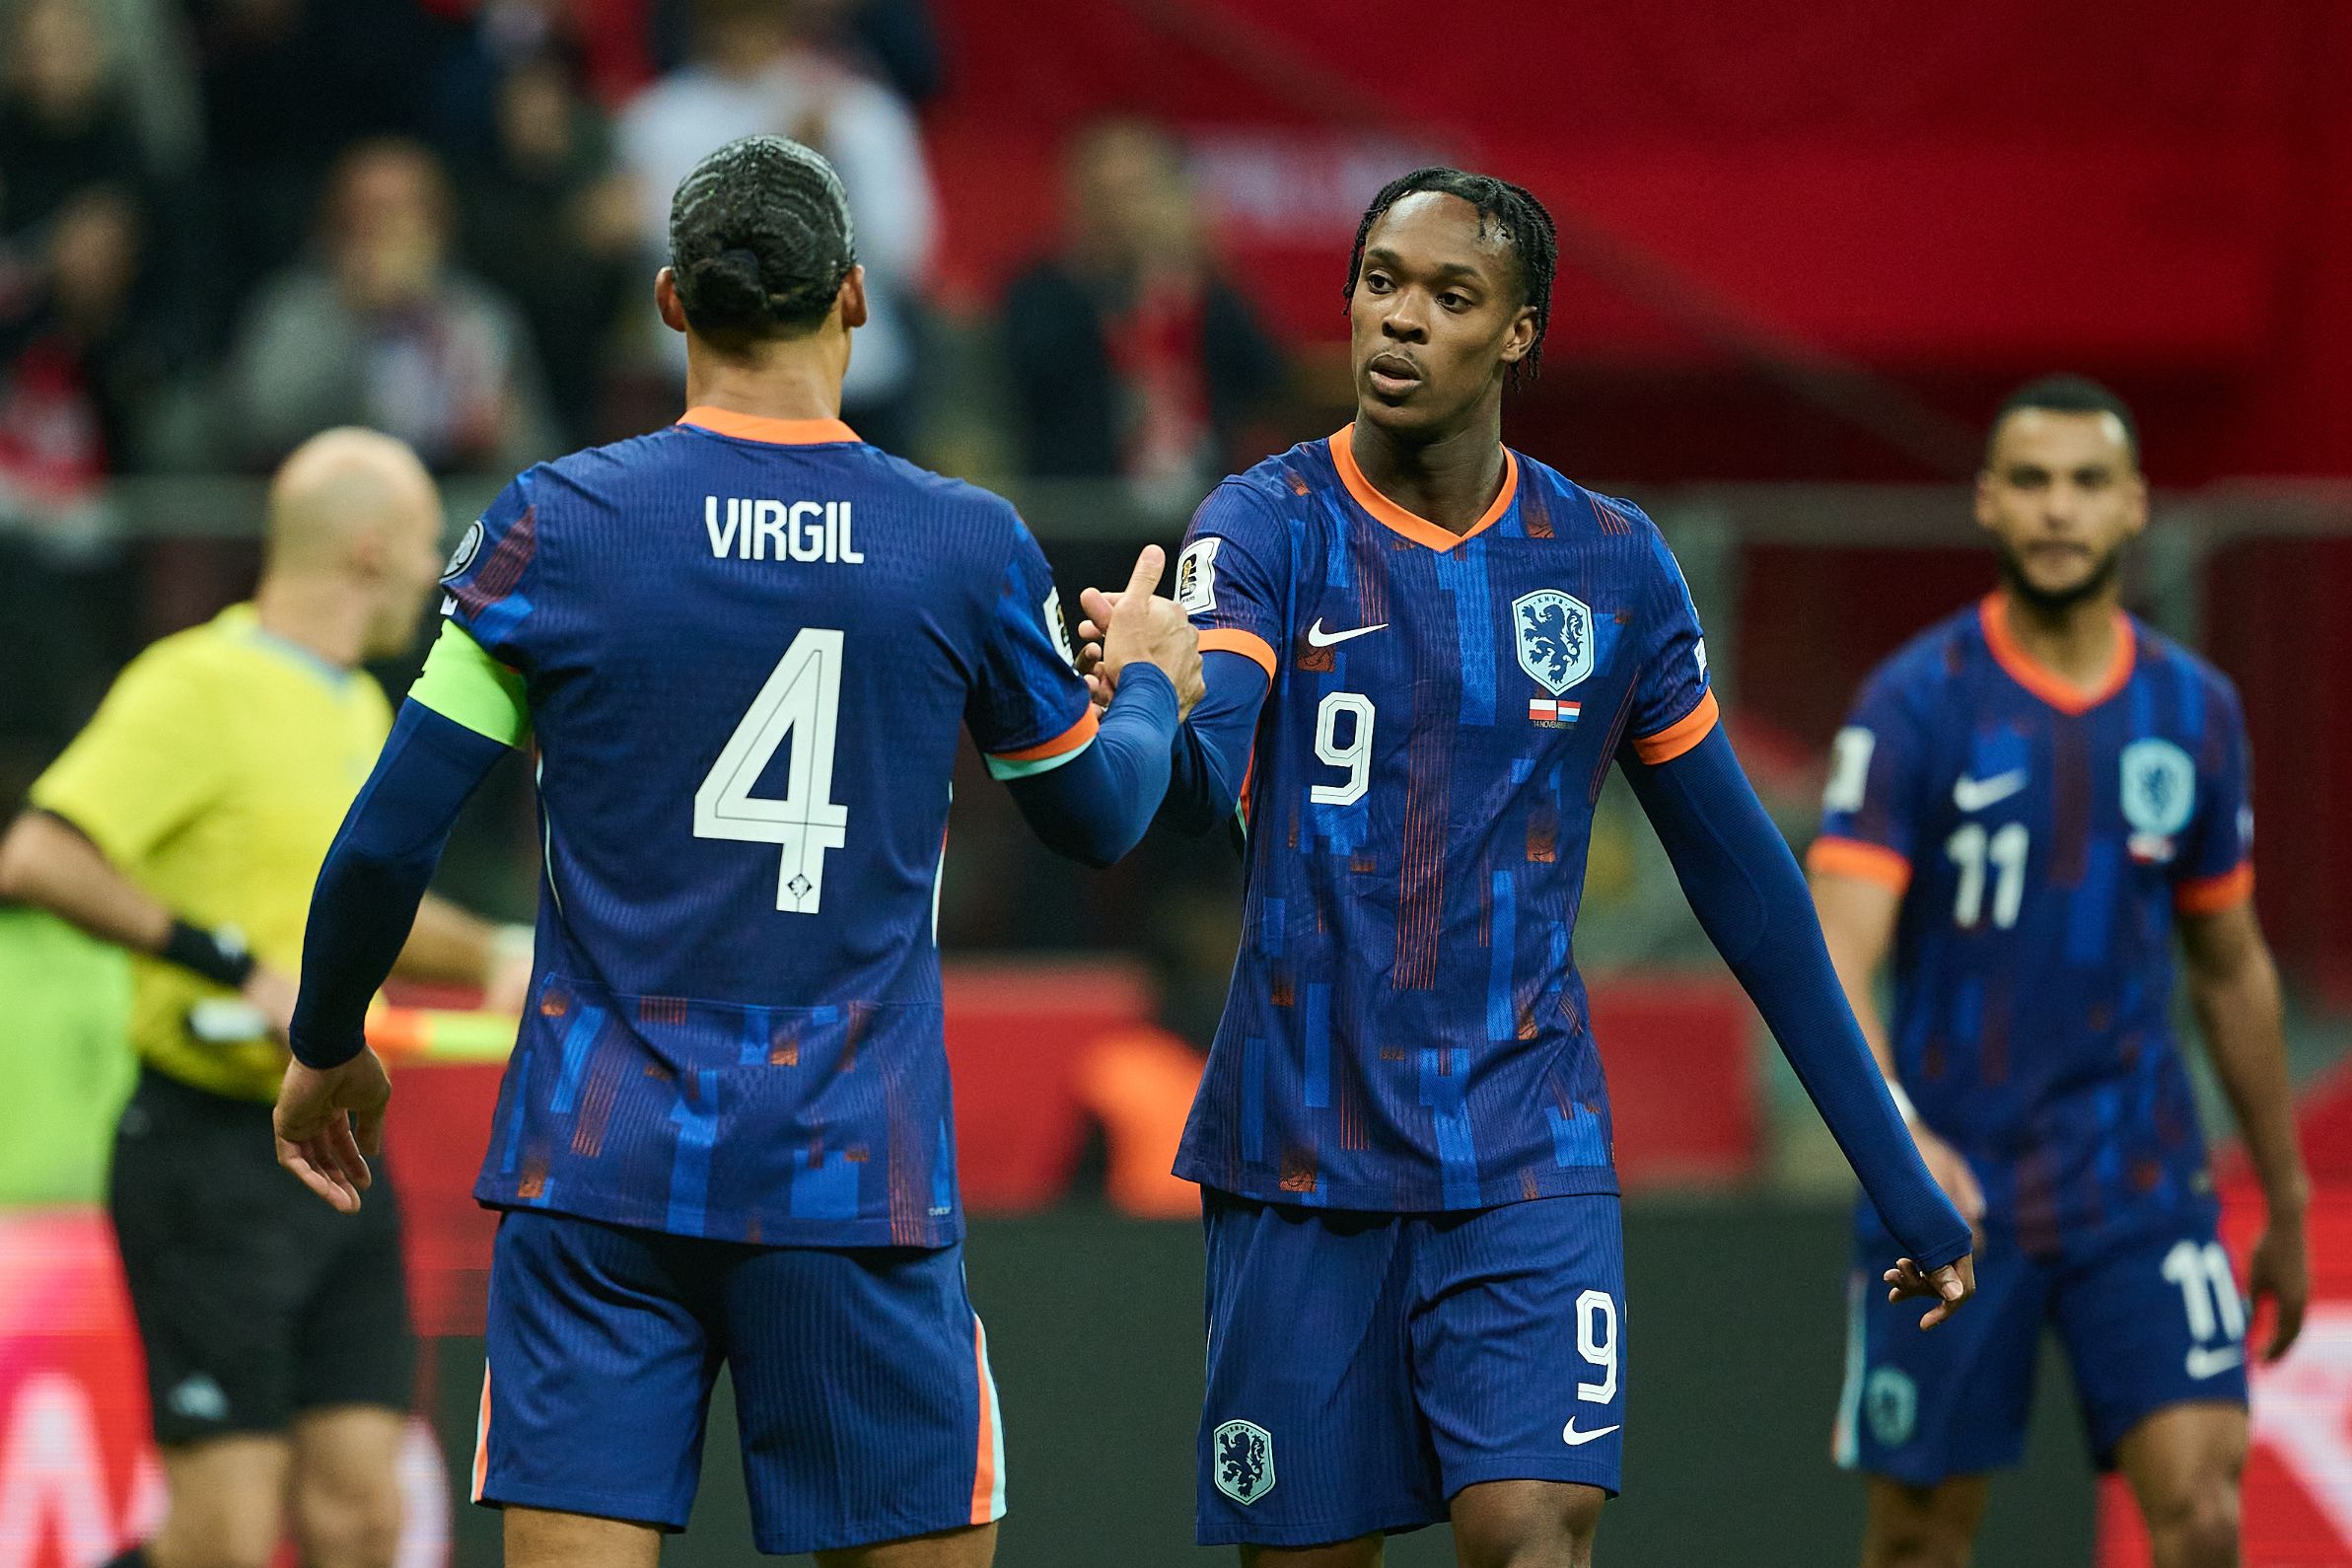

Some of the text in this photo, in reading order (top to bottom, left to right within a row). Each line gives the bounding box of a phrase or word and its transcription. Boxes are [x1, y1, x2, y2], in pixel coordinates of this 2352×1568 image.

[705, 495, 865, 564] VIRGIL
[692, 627, 848, 915] 4
[1310, 691, 1376, 807] 9
[1946, 821, 2031, 930] 11
[1575, 1289, 1618, 1404] 9
[2161, 1240, 2245, 1342] 11
